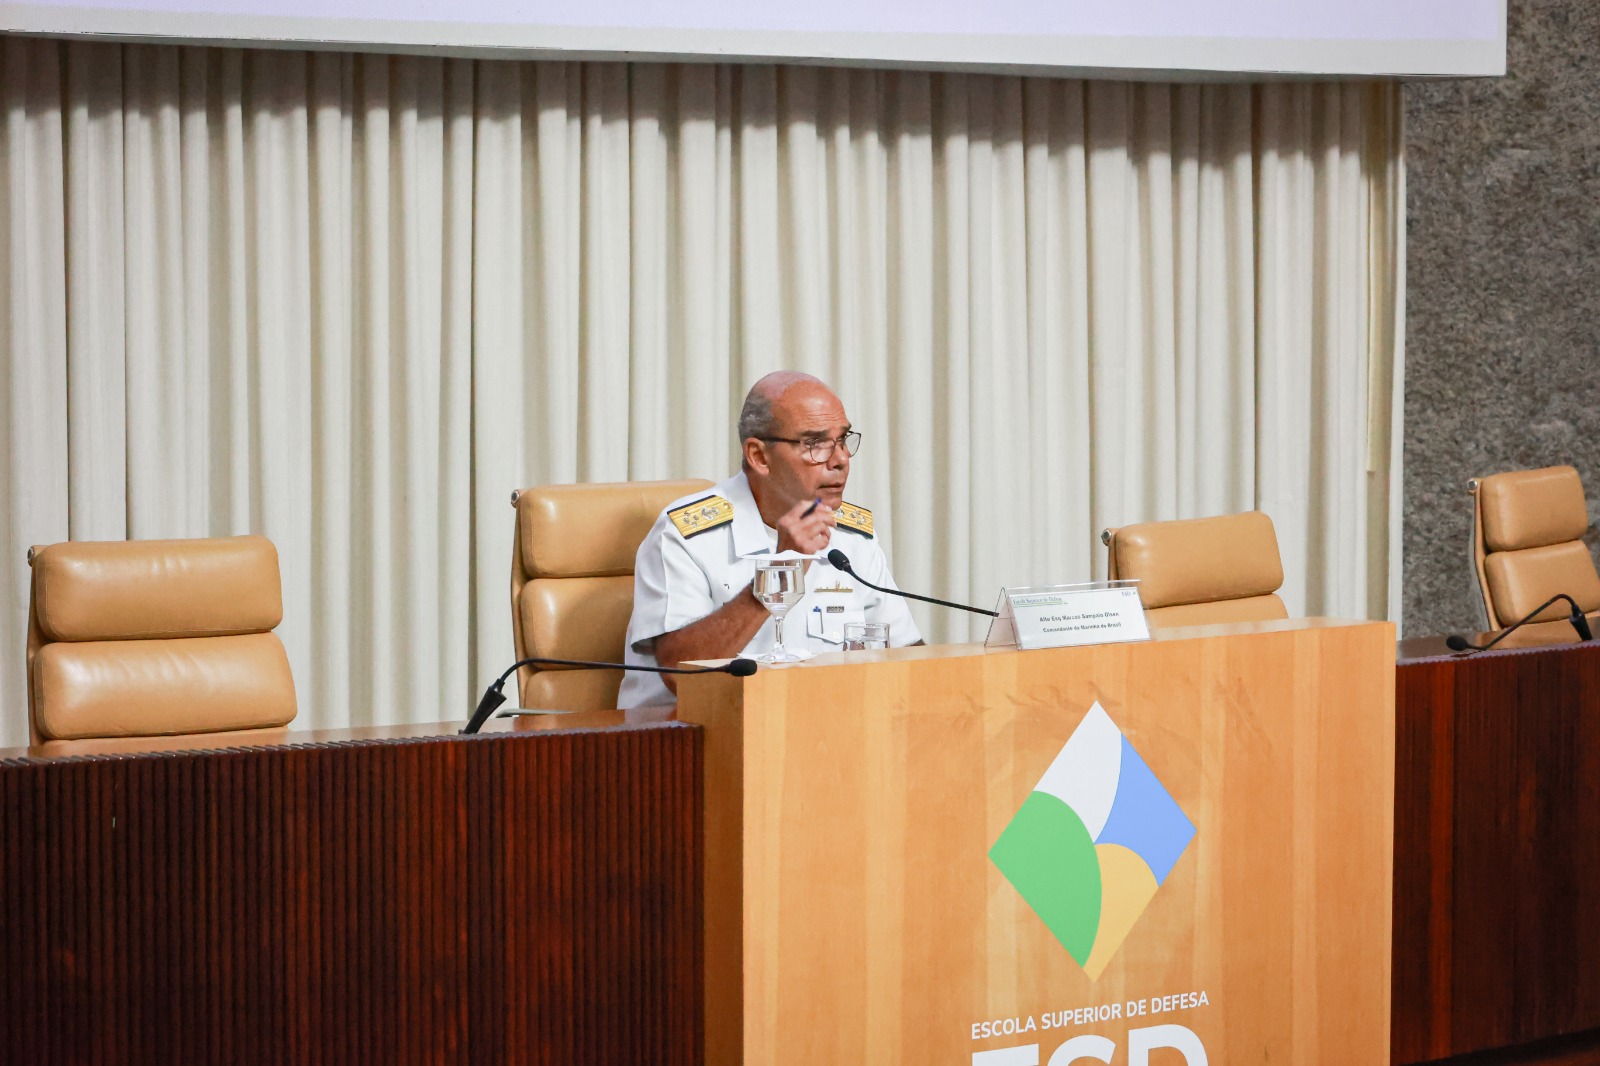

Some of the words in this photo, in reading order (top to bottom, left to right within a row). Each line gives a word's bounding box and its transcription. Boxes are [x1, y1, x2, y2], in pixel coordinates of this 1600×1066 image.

[971, 1015, 1037, 1040] ESCOLA
[1041, 1003, 1121, 1030] SUPERIOR
[1126, 999, 1147, 1017] DE
[1151, 990, 1210, 1014] DEFESA
